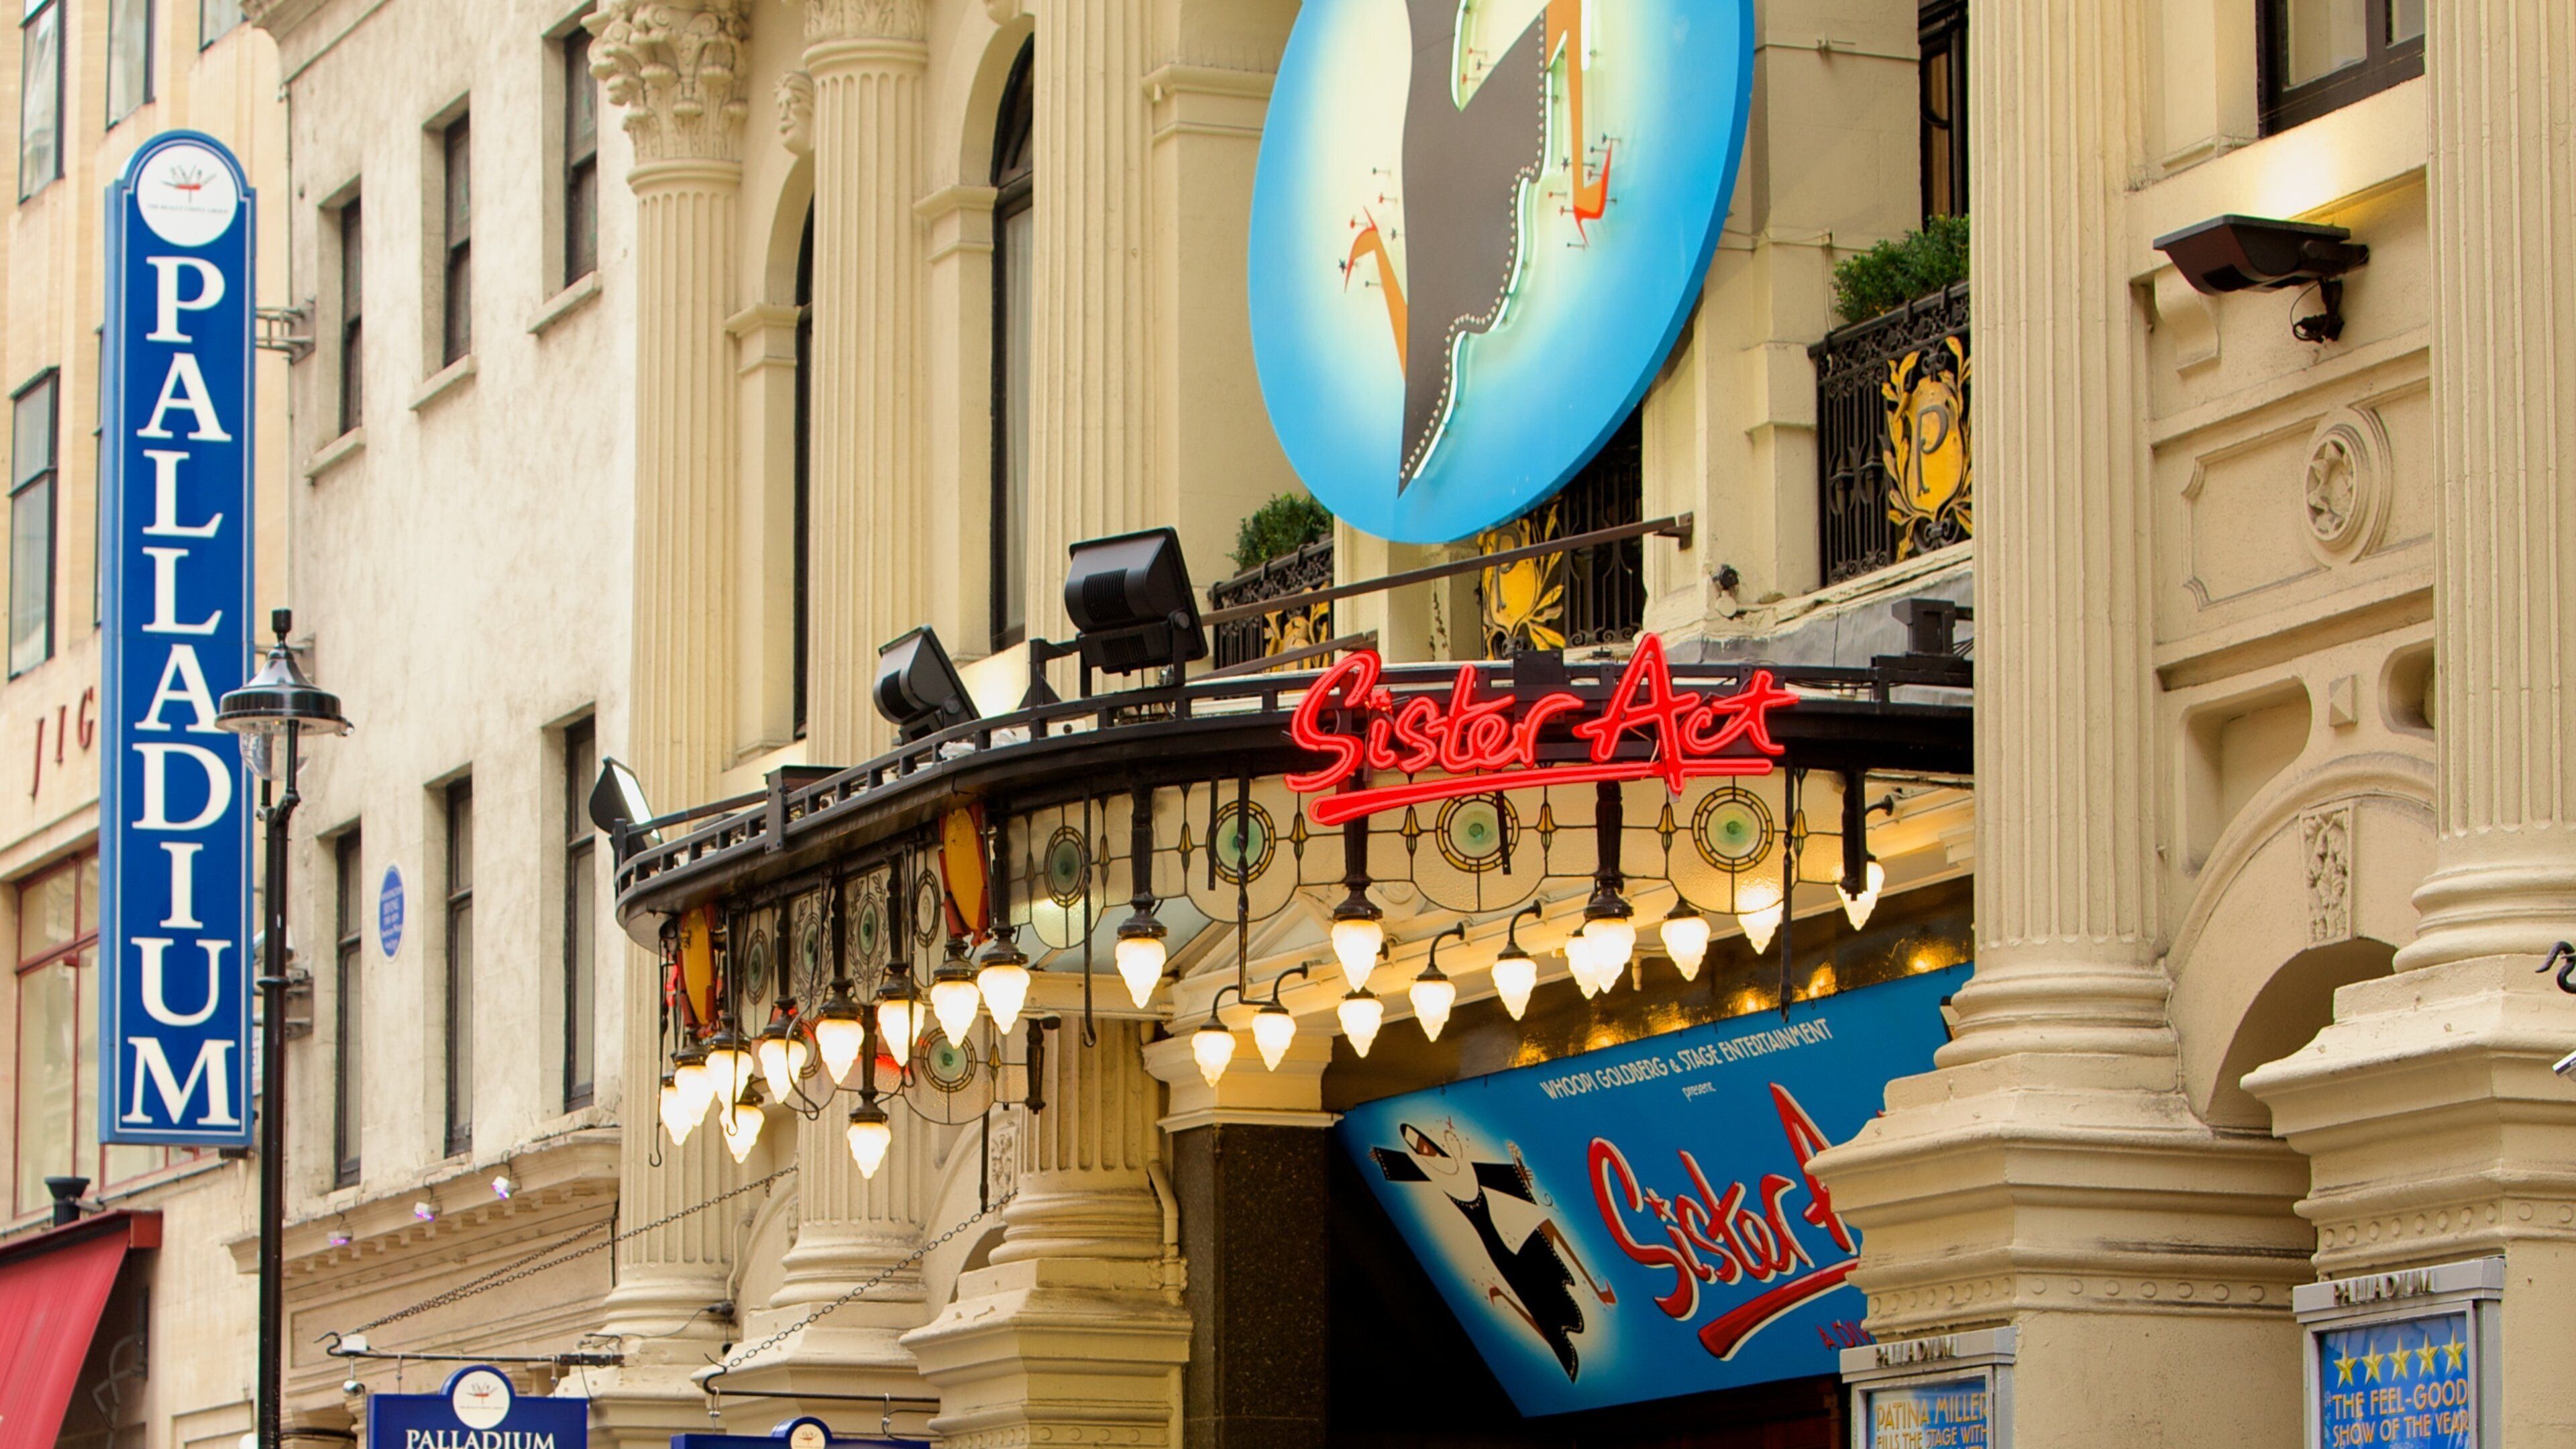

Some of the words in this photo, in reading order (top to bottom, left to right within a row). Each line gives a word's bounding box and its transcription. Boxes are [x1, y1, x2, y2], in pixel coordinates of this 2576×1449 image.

[121, 256, 240, 1126] PALLADIUM
[1284, 650, 1584, 793] Sister
[1572, 633, 1800, 794] Act
[1540, 1072, 1599, 1100] WHOOPI
[1595, 1057, 1668, 1089] GOLDBERG
[1669, 1059, 1681, 1073] &
[1677, 1044, 1723, 1071] STAGE
[1721, 1018, 1834, 1063] ENTERTAINMENT
[1587, 1136, 1815, 1321] Sister
[1874, 1399, 1930, 1431] PATINA
[2332, 1391, 2364, 1420] THE
[2370, 1379, 2469, 1415] FEEL-GOOD
[406, 1430, 555, 1449] PALLADIUM
[1876, 1434, 1900, 1449] FILLS
[1902, 1431, 1923, 1449] THE
[1925, 1426, 1957, 1448] STAGE
[2333, 1421, 2375, 1448] SHOW
[2380, 1417, 2400, 1442] OF
[2404, 1413, 2431, 1438] THE
[2434, 1409, 2469, 1435] YEAR
